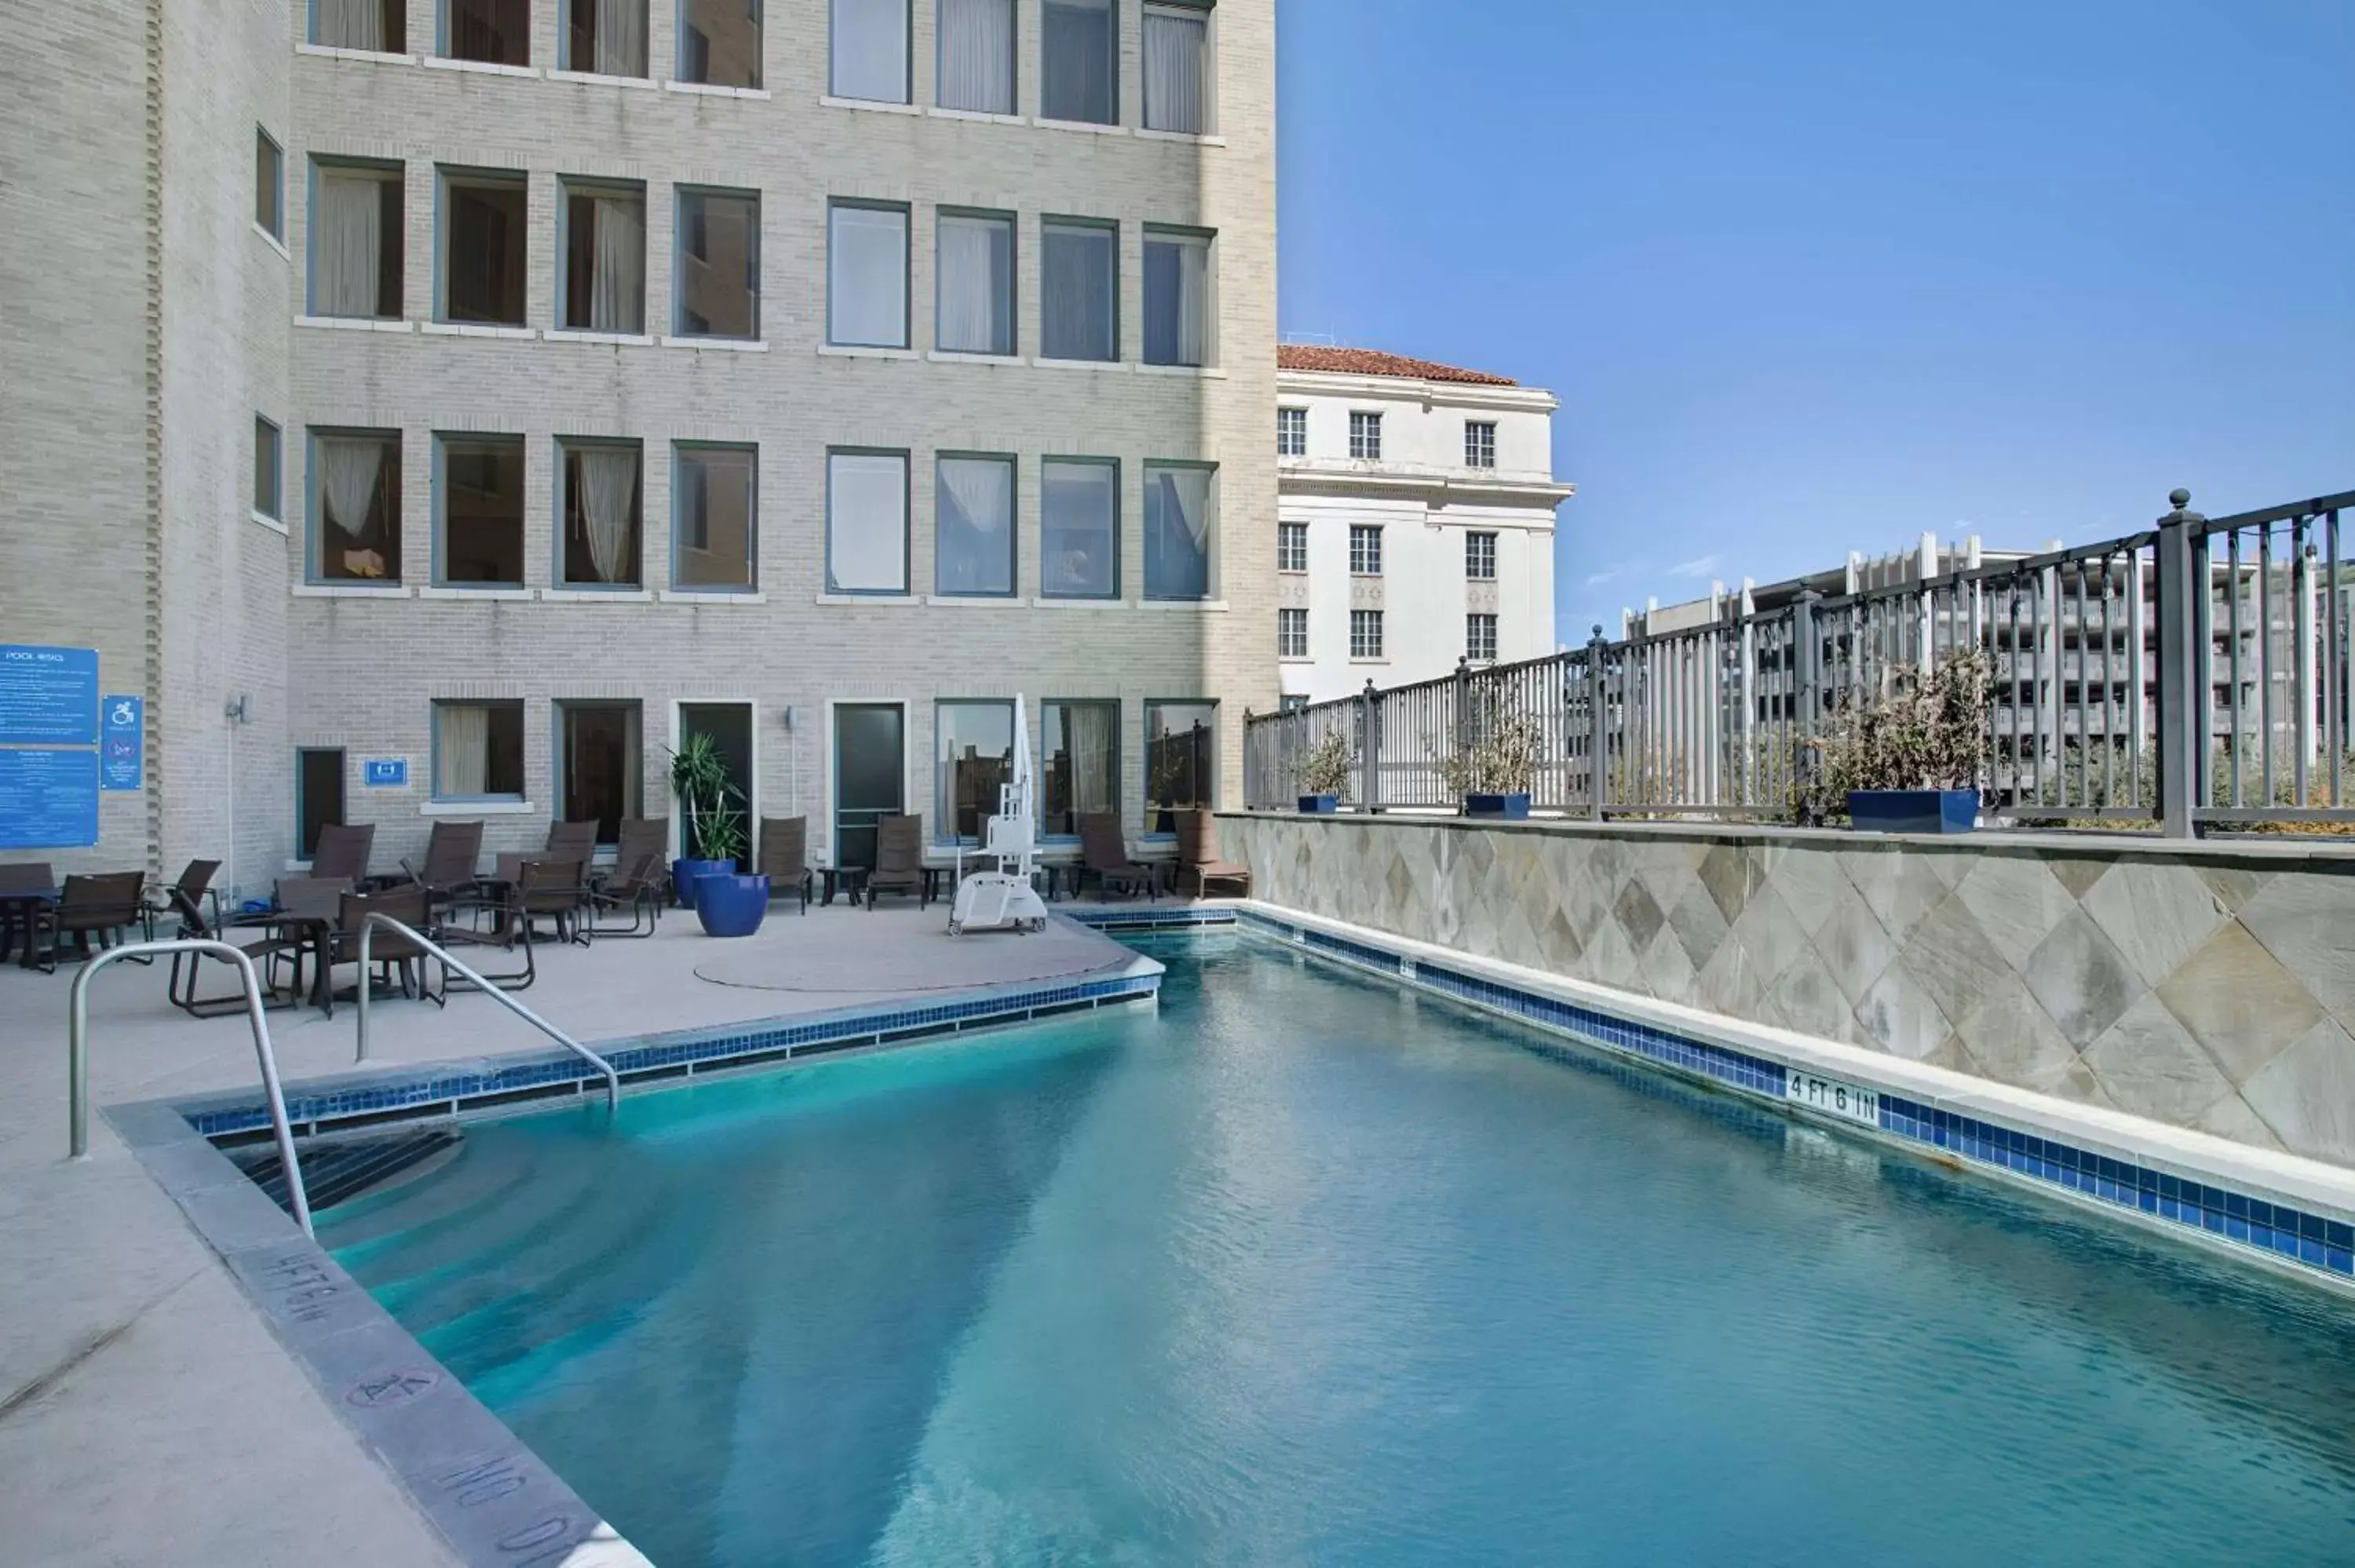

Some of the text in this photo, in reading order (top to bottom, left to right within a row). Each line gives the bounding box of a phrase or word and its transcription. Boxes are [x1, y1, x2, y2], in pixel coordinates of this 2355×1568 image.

[1791, 1074, 1875, 1120] 4 FT 6 IN
[436, 1456, 527, 1508] NO
